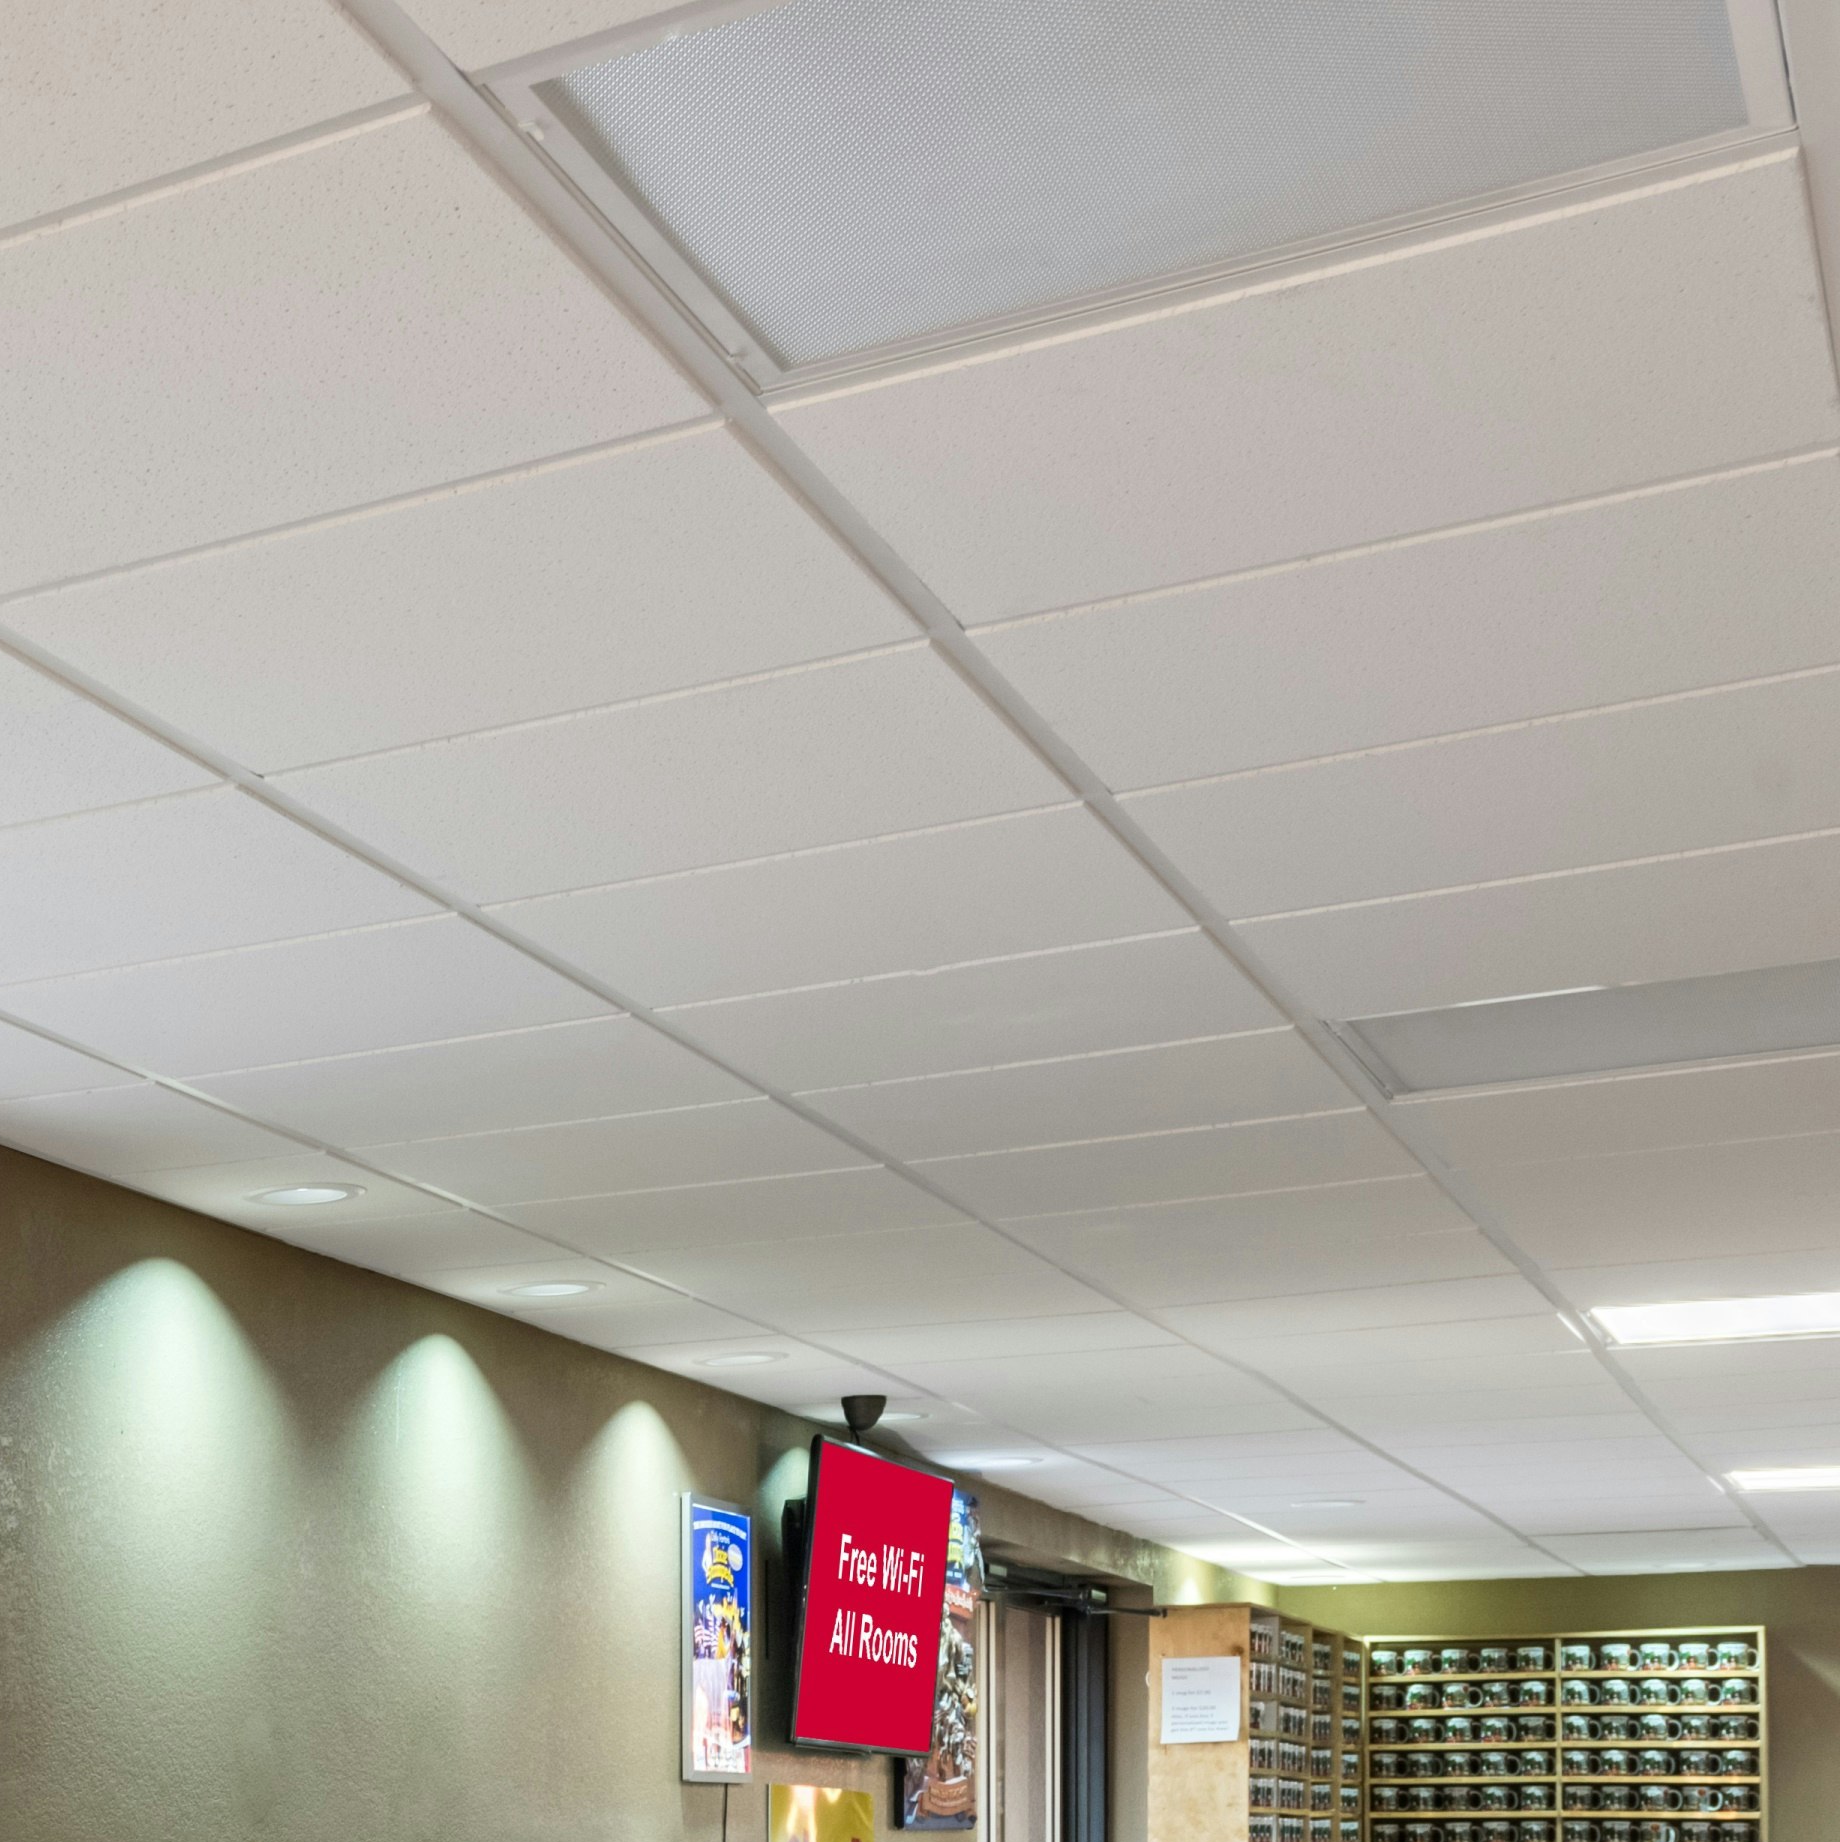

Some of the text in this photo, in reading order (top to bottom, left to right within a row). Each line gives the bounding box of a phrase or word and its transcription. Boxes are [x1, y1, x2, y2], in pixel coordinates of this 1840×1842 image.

[838, 1533, 925, 1598] Free Wi-Fi
[829, 1608, 918, 1669] All Rooms
